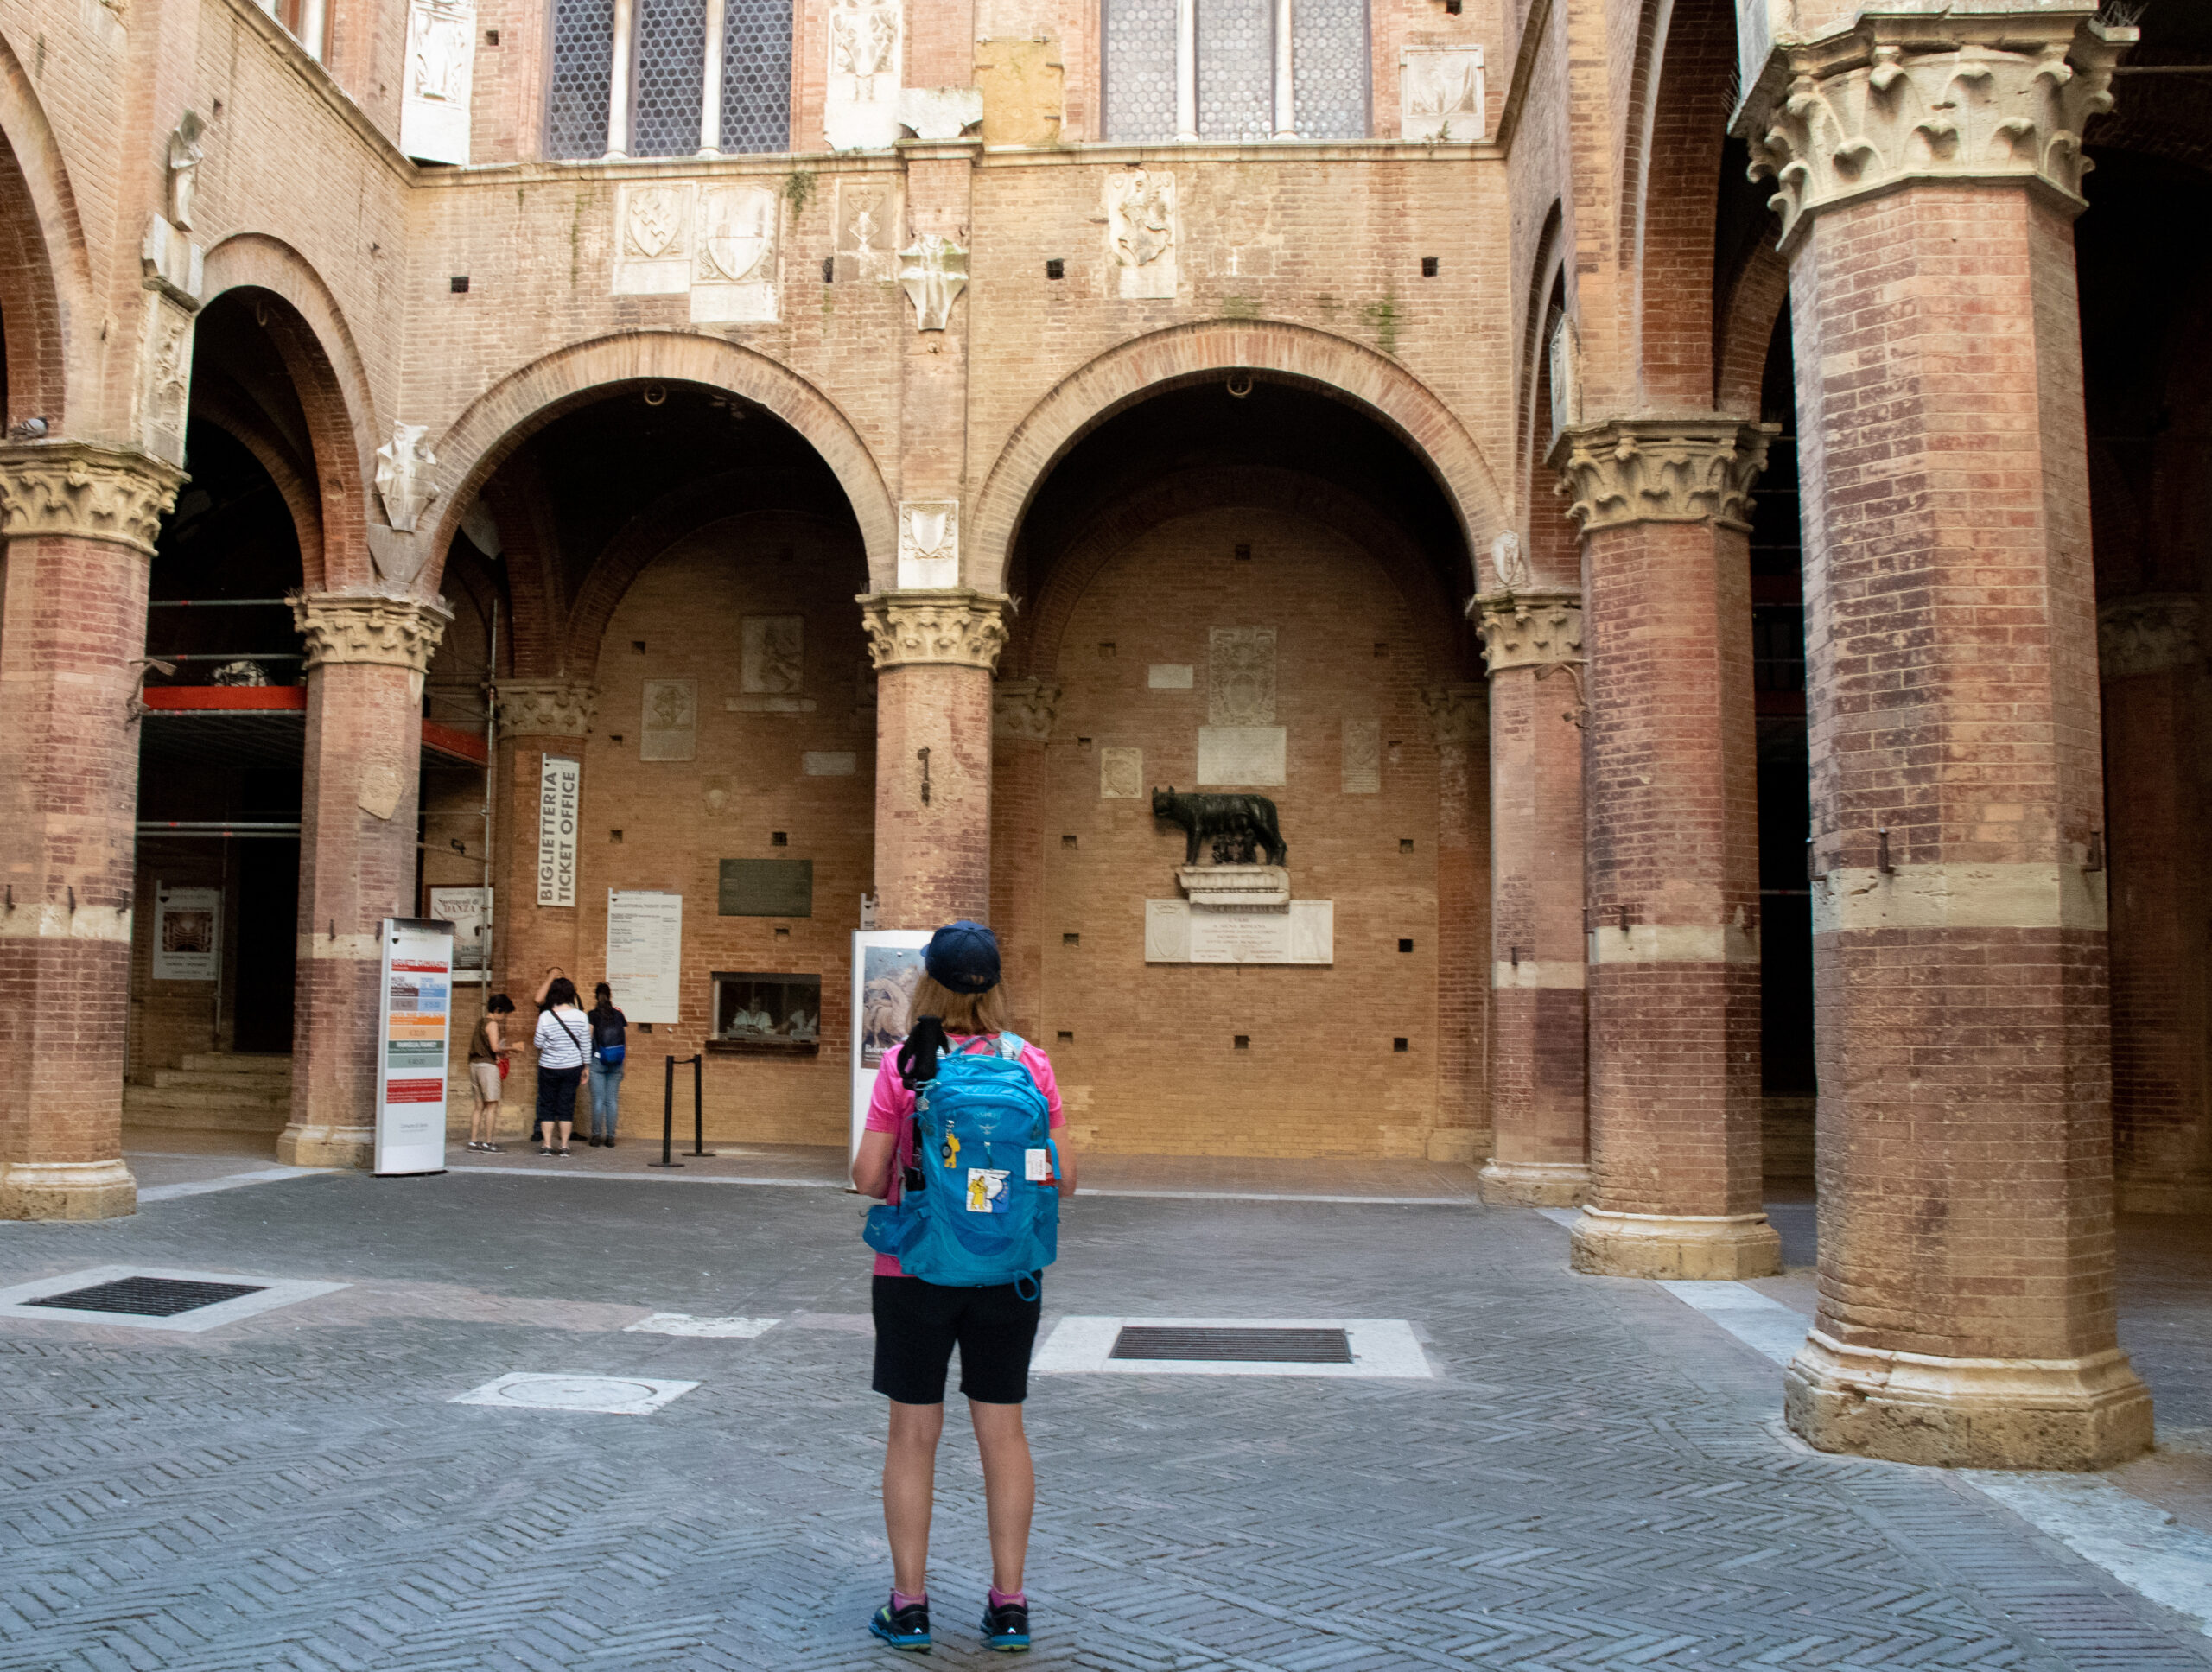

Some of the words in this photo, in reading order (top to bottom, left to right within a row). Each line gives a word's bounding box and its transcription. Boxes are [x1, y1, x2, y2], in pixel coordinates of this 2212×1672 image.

[560, 772, 575, 836] OFFICE
[540, 772, 557, 901] BIGLIETTERIA
[558, 841, 573, 902] TICKET
[443, 905, 476, 913] DANZA
